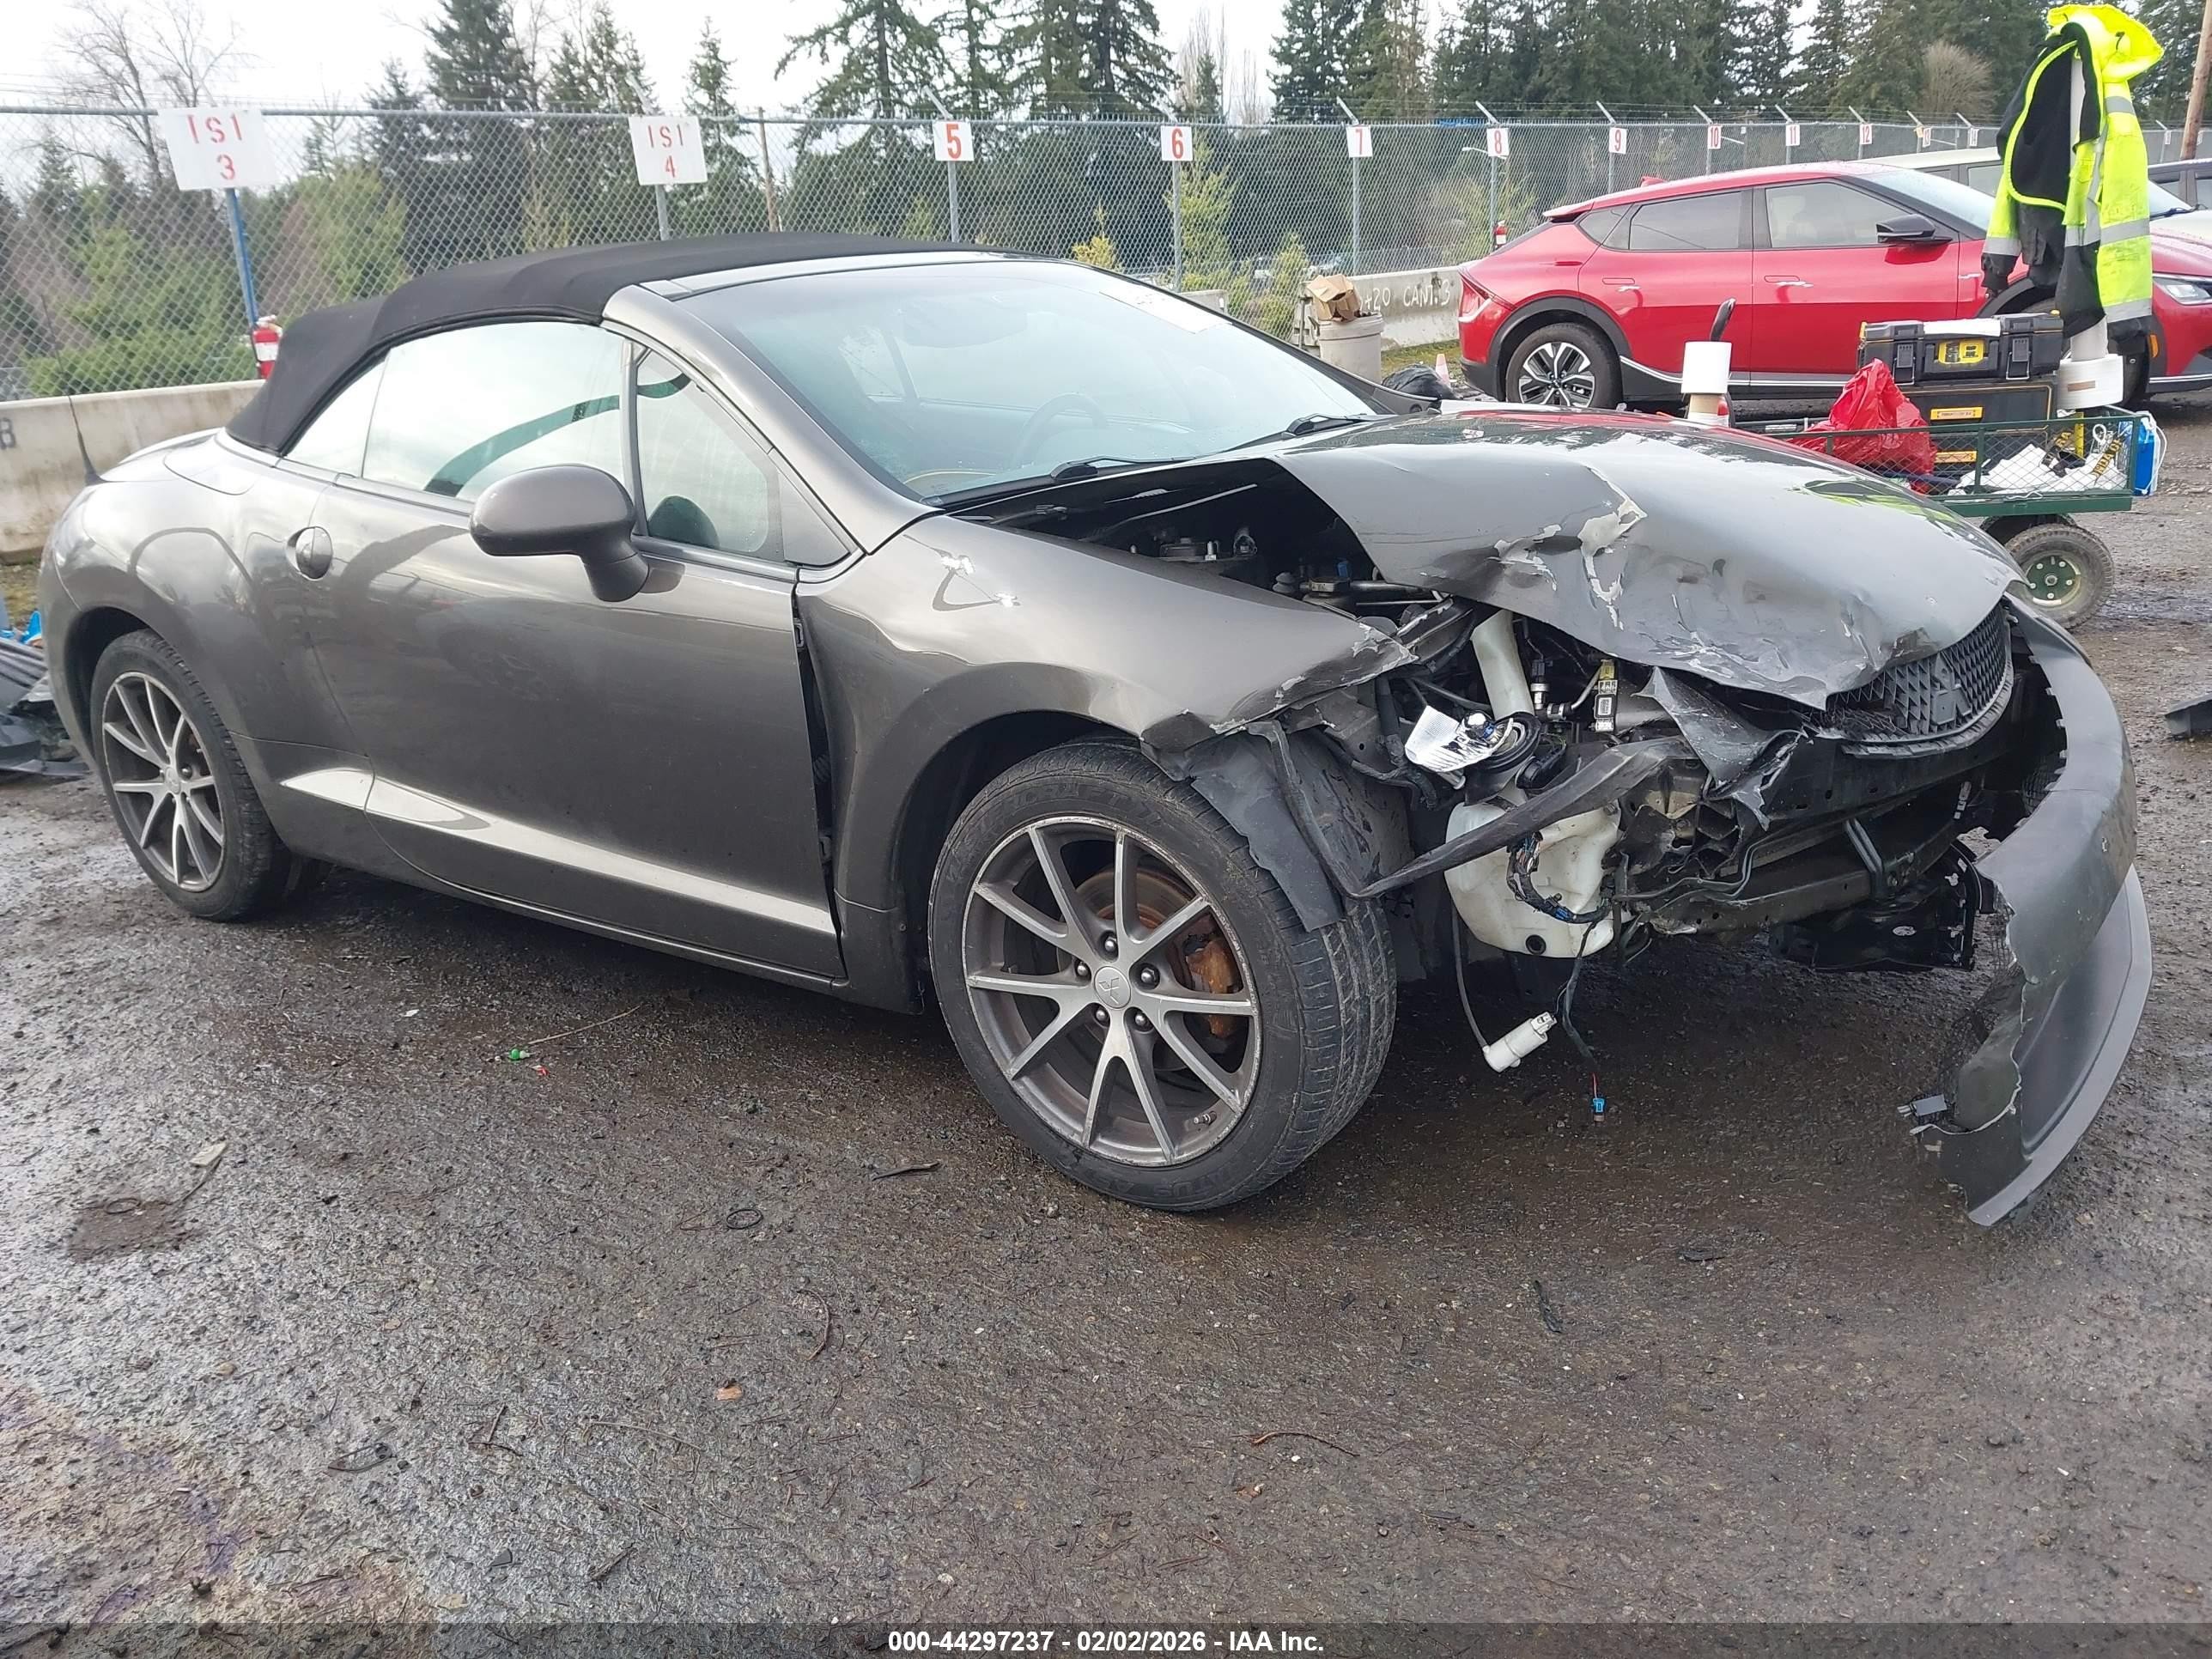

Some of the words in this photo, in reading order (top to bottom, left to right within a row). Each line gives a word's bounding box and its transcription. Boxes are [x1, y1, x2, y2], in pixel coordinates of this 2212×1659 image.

[946, 123, 962, 160] 5
[1171, 128, 1184, 160] 6
[1494, 130, 1502, 155] 8
[1613, 129, 1622, 152] 9
[1710, 126, 1719, 148] 10
[1862, 125, 1870, 143] 12
[216, 154, 236, 180] 3
[665, 155, 677, 179] 4
